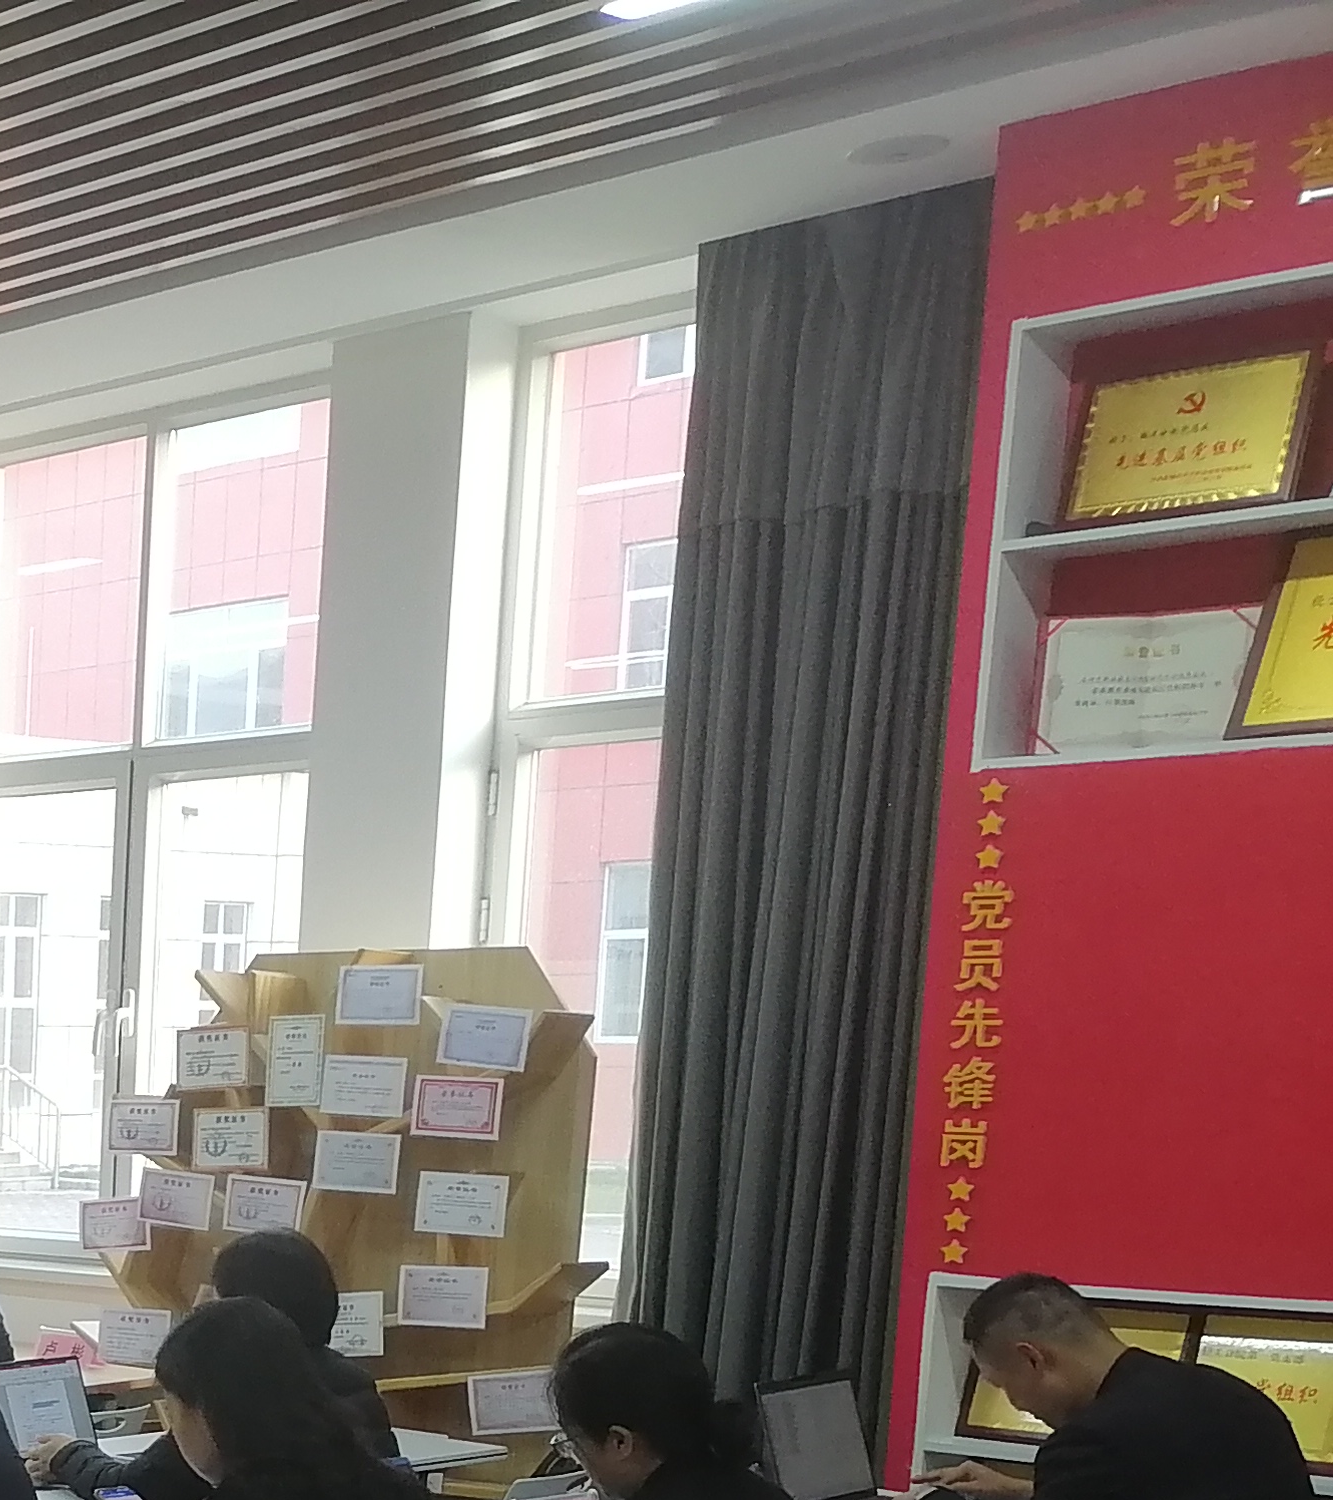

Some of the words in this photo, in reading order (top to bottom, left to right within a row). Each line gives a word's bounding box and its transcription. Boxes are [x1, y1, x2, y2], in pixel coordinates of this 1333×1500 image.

[939, 880, 1014, 1168] 党员先锋岗
